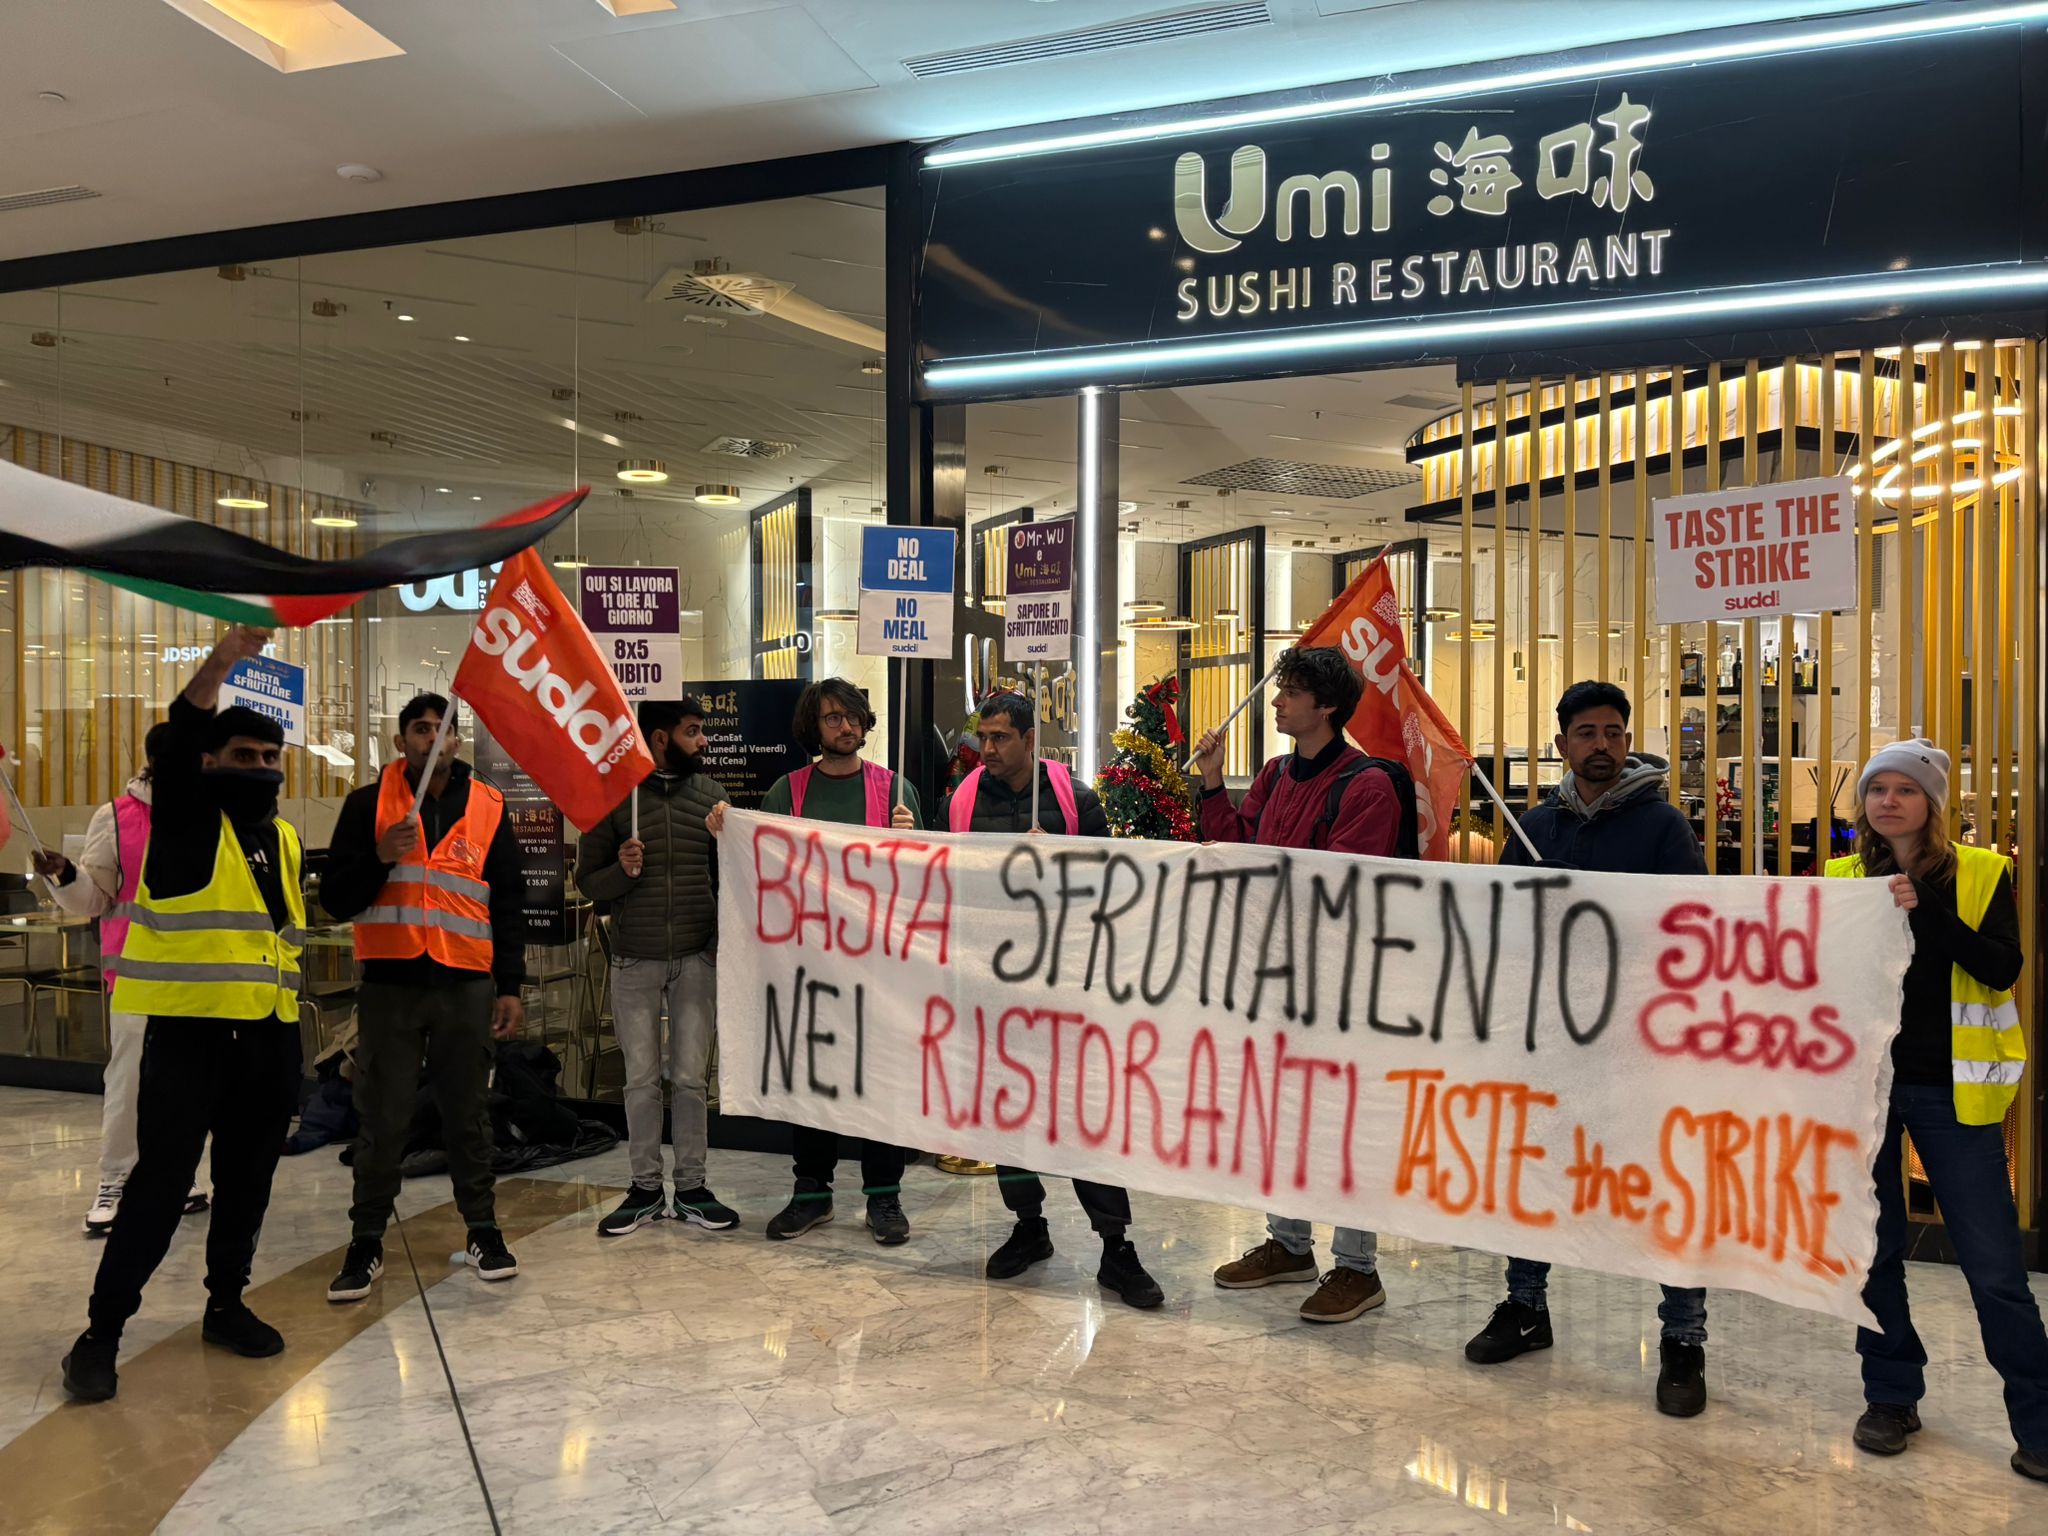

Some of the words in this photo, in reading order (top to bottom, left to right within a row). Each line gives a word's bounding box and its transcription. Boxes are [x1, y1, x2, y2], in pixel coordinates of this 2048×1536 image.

[1174, 142, 1392, 253] Umi
[1426, 91, 1654, 216] 海味
[1176, 266, 1312, 320] SUSHI
[1332, 228, 1672, 305] RESTAURANT
[1664, 502, 1765, 550] TASTE
[1776, 492, 1841, 538] THE
[897, 537, 920, 559] NO
[887, 559, 928, 581] DEAL
[1015, 562, 1036, 579] Umi
[1694, 540, 1810, 589] STRIKE
[585, 576, 606, 593] QUI
[610, 576, 623, 592] SI
[625, 576, 673, 593] LAVORA
[601, 593, 613, 609] 11
[616, 593, 640, 609] ORE
[643, 593, 659, 609] AL
[896, 597, 918, 618] NO
[1017, 602, 1050, 620] SAPORE
[1052, 601, 1060, 618] DI
[608, 609, 654, 626] GIORNO
[1007, 619, 1068, 638] SFRUTTAMENTO
[883, 619, 928, 641] MEAL
[614, 638, 649, 660] 8x5
[246, 667, 280, 687] BASTA
[611, 663, 662, 684] UBITO
[233, 674, 292, 699] SFRUTTARE
[235, 695, 283, 718] RISPETTA
[285, 710, 290, 719] I
[739, 744, 747, 753] al
[719, 756, 747, 766] (Cena)
[752, 825, 953, 964] BASTA
[991, 843, 1619, 1052] SFRUTTAMENTO
[760, 965, 866, 1098] NEI
[919, 994, 1358, 1197] RISTORANTI
[1385, 1068, 1559, 1228] TASTE
[1564, 1123, 1653, 1222] the
[1650, 1104, 1860, 1279] STRIKE
